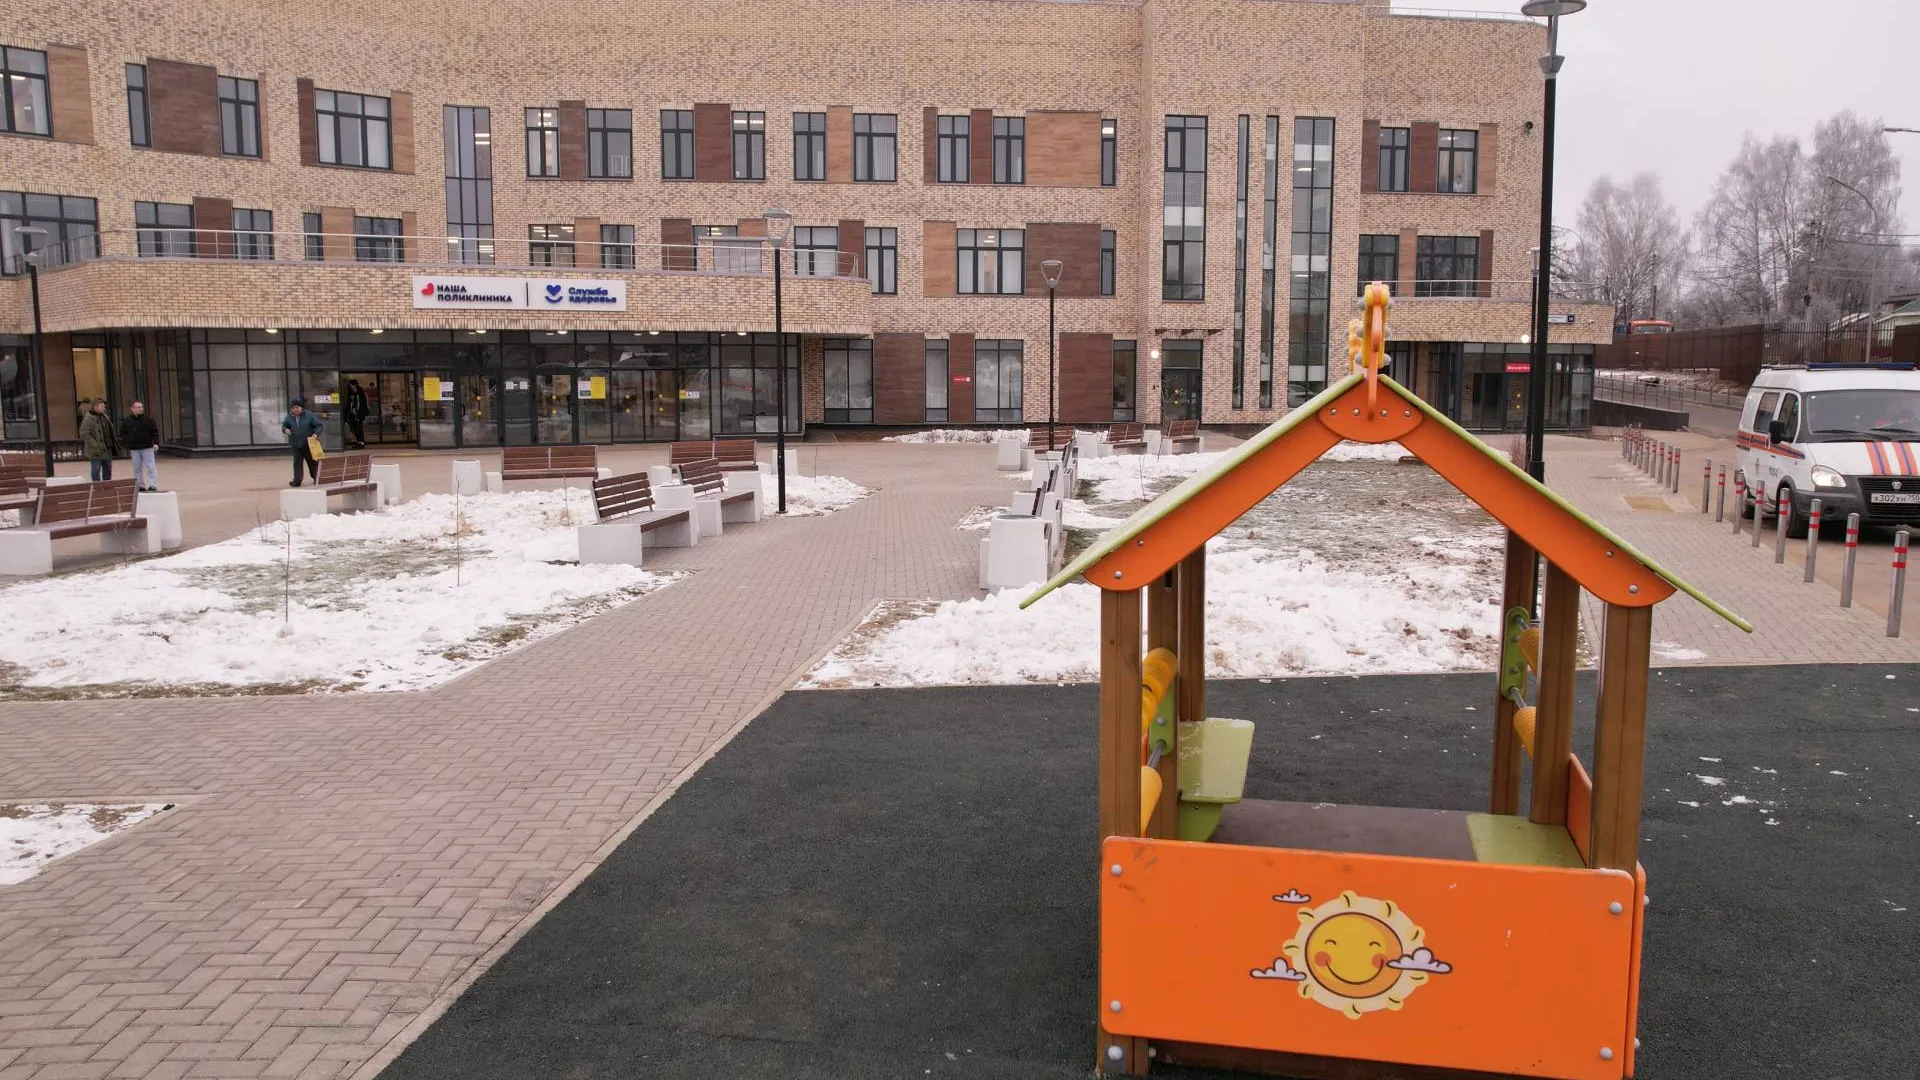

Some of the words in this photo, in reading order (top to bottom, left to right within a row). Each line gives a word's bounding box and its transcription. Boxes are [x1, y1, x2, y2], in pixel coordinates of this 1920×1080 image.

[568, 287, 609, 297] Служба
[437, 294, 513, 303] ПОЛИКЛИНИКА
[568, 296, 618, 304] здоровья
